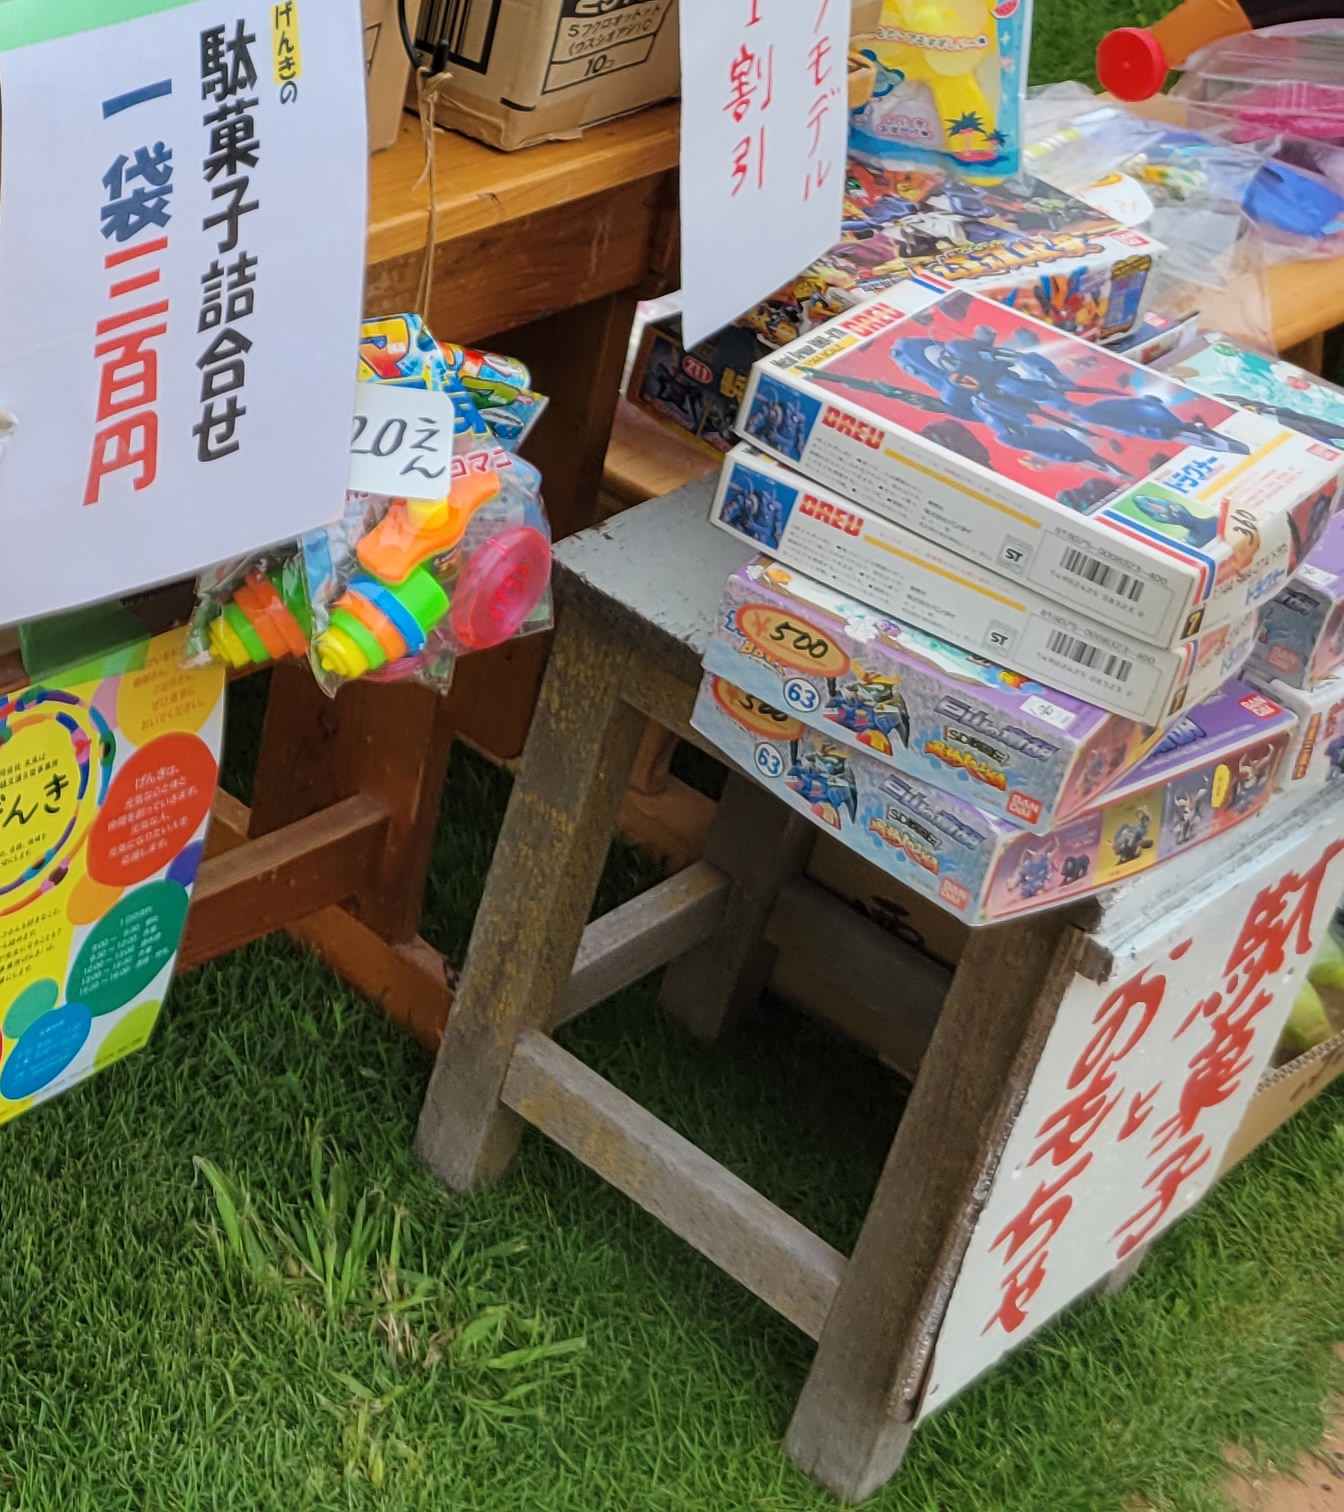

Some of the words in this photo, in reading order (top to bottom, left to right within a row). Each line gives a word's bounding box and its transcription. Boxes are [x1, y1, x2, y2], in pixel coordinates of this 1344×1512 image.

[274, 0, 300, 106] げんきの
[190, 18, 261, 464] 駄菓子詰合せ
[787, 682, 816, 707] 63
[759, 747, 782, 772] 63
[979, 937, 1194, 1337] おもちゃ
